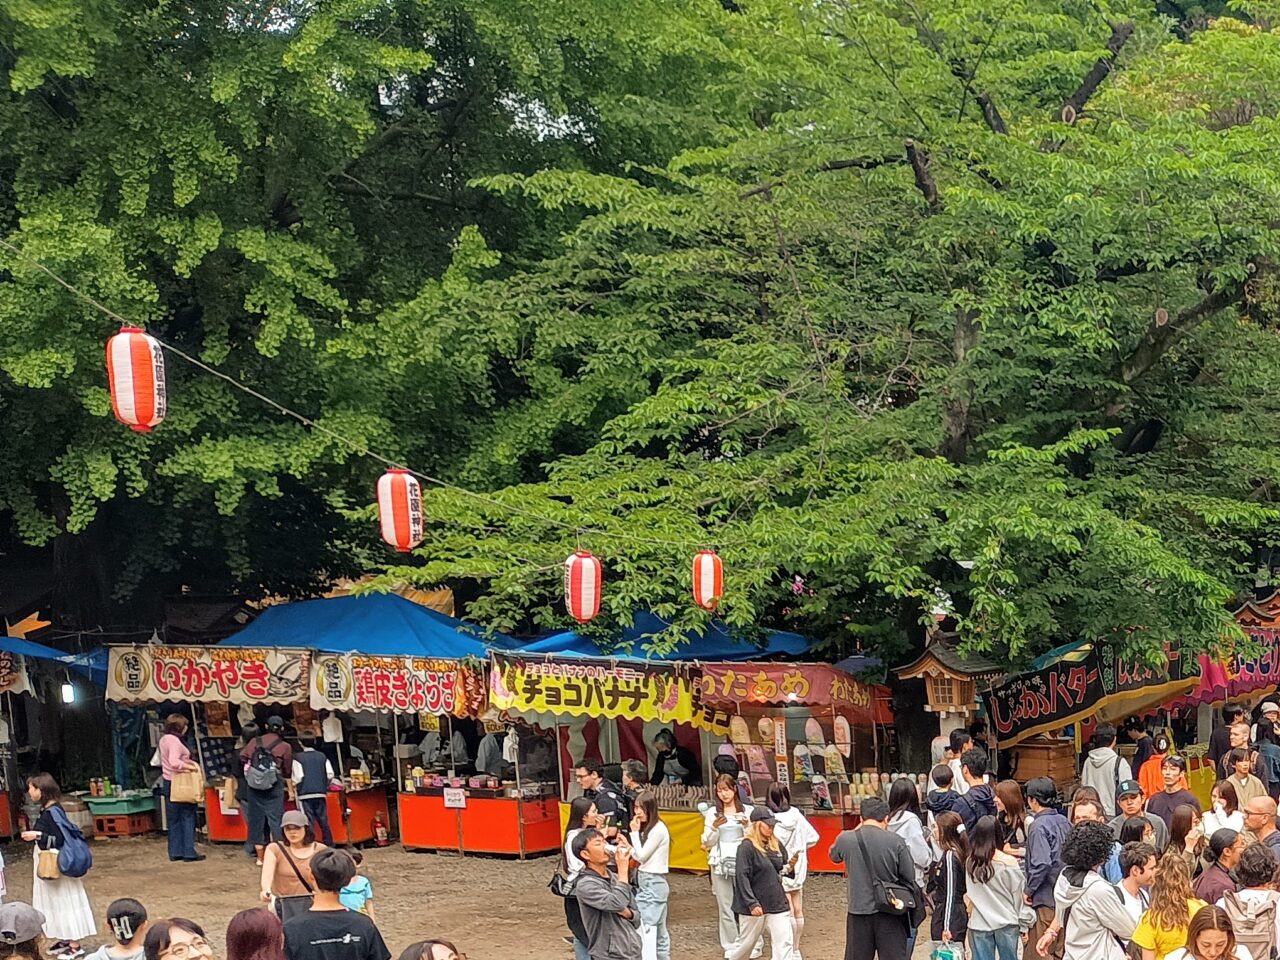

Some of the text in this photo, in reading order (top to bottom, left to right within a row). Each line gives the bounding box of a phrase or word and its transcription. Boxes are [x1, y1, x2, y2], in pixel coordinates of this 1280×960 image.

[409, 482, 421, 542] 花園神社
[154, 658, 270, 698] いかやき
[525, 662, 645, 681] チョコとバナナのハーモニー
[522, 679, 649, 711] チョコバナナ
[830, 674, 871, 709] わたあめ
[989, 665, 1098, 733] じゃがバター
